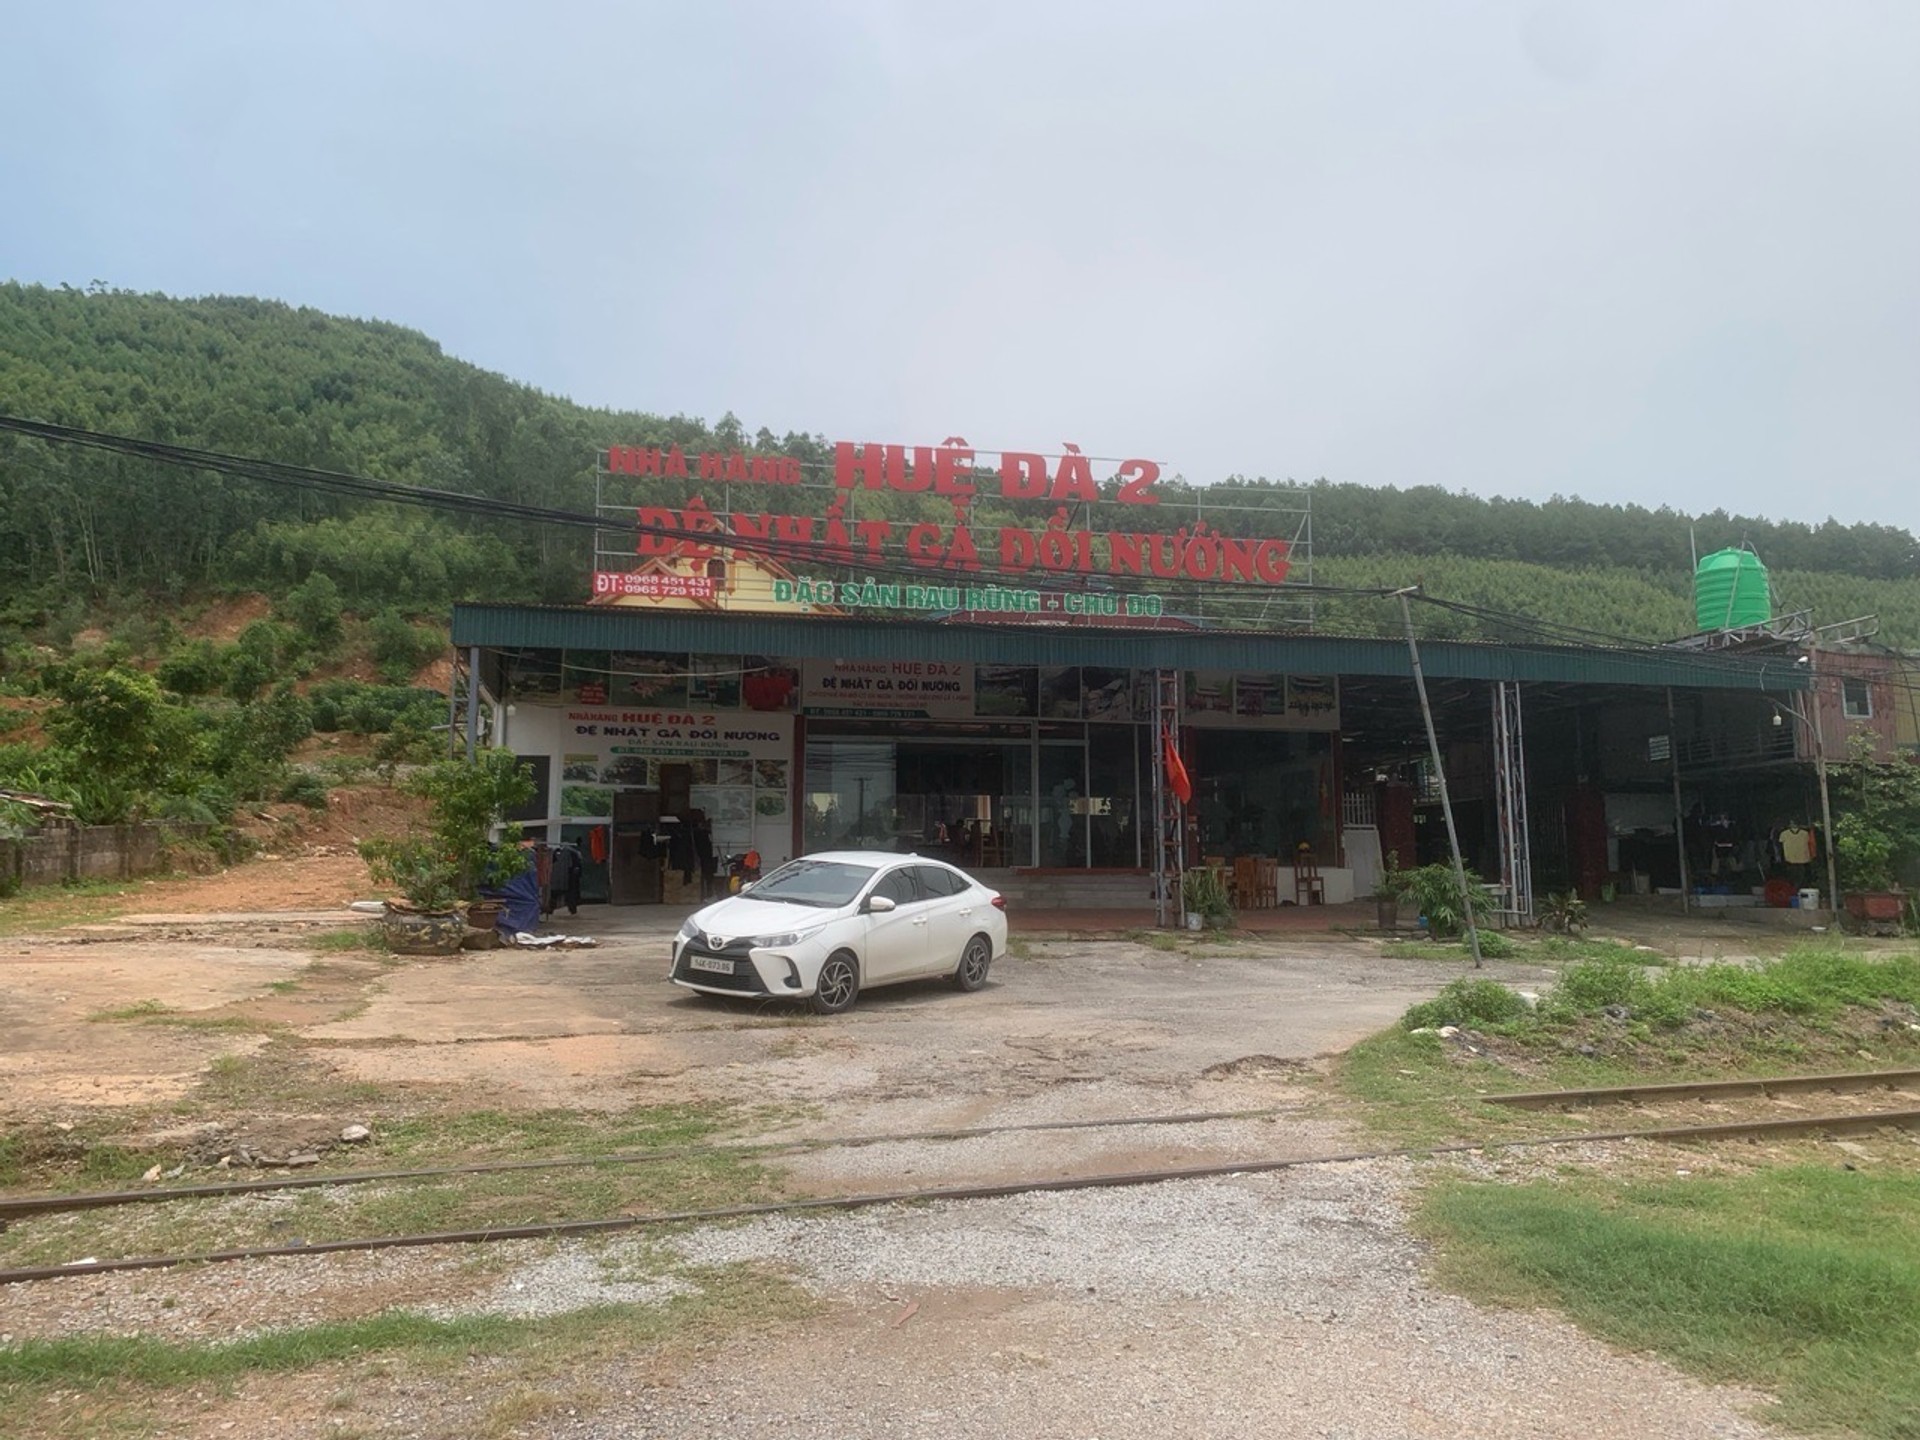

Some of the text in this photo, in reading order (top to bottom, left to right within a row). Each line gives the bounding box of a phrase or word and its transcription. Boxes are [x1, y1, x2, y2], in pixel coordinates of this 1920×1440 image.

[609, 437, 1161, 506] NHÀ HÀNG HUỆ ĐÀ 2
[597, 574, 711, 593] ĐT: 0968 451 431
[625, 584, 711, 597] 0965 729 131
[773, 576, 834, 613] ĐẶC
[842, 576, 900, 608] SẢN
[906, 585, 960, 611] RAU
[966, 583, 1041, 613] RỪNG
[952, 665, 961, 676] 2
[702, 715, 715, 726] 2
